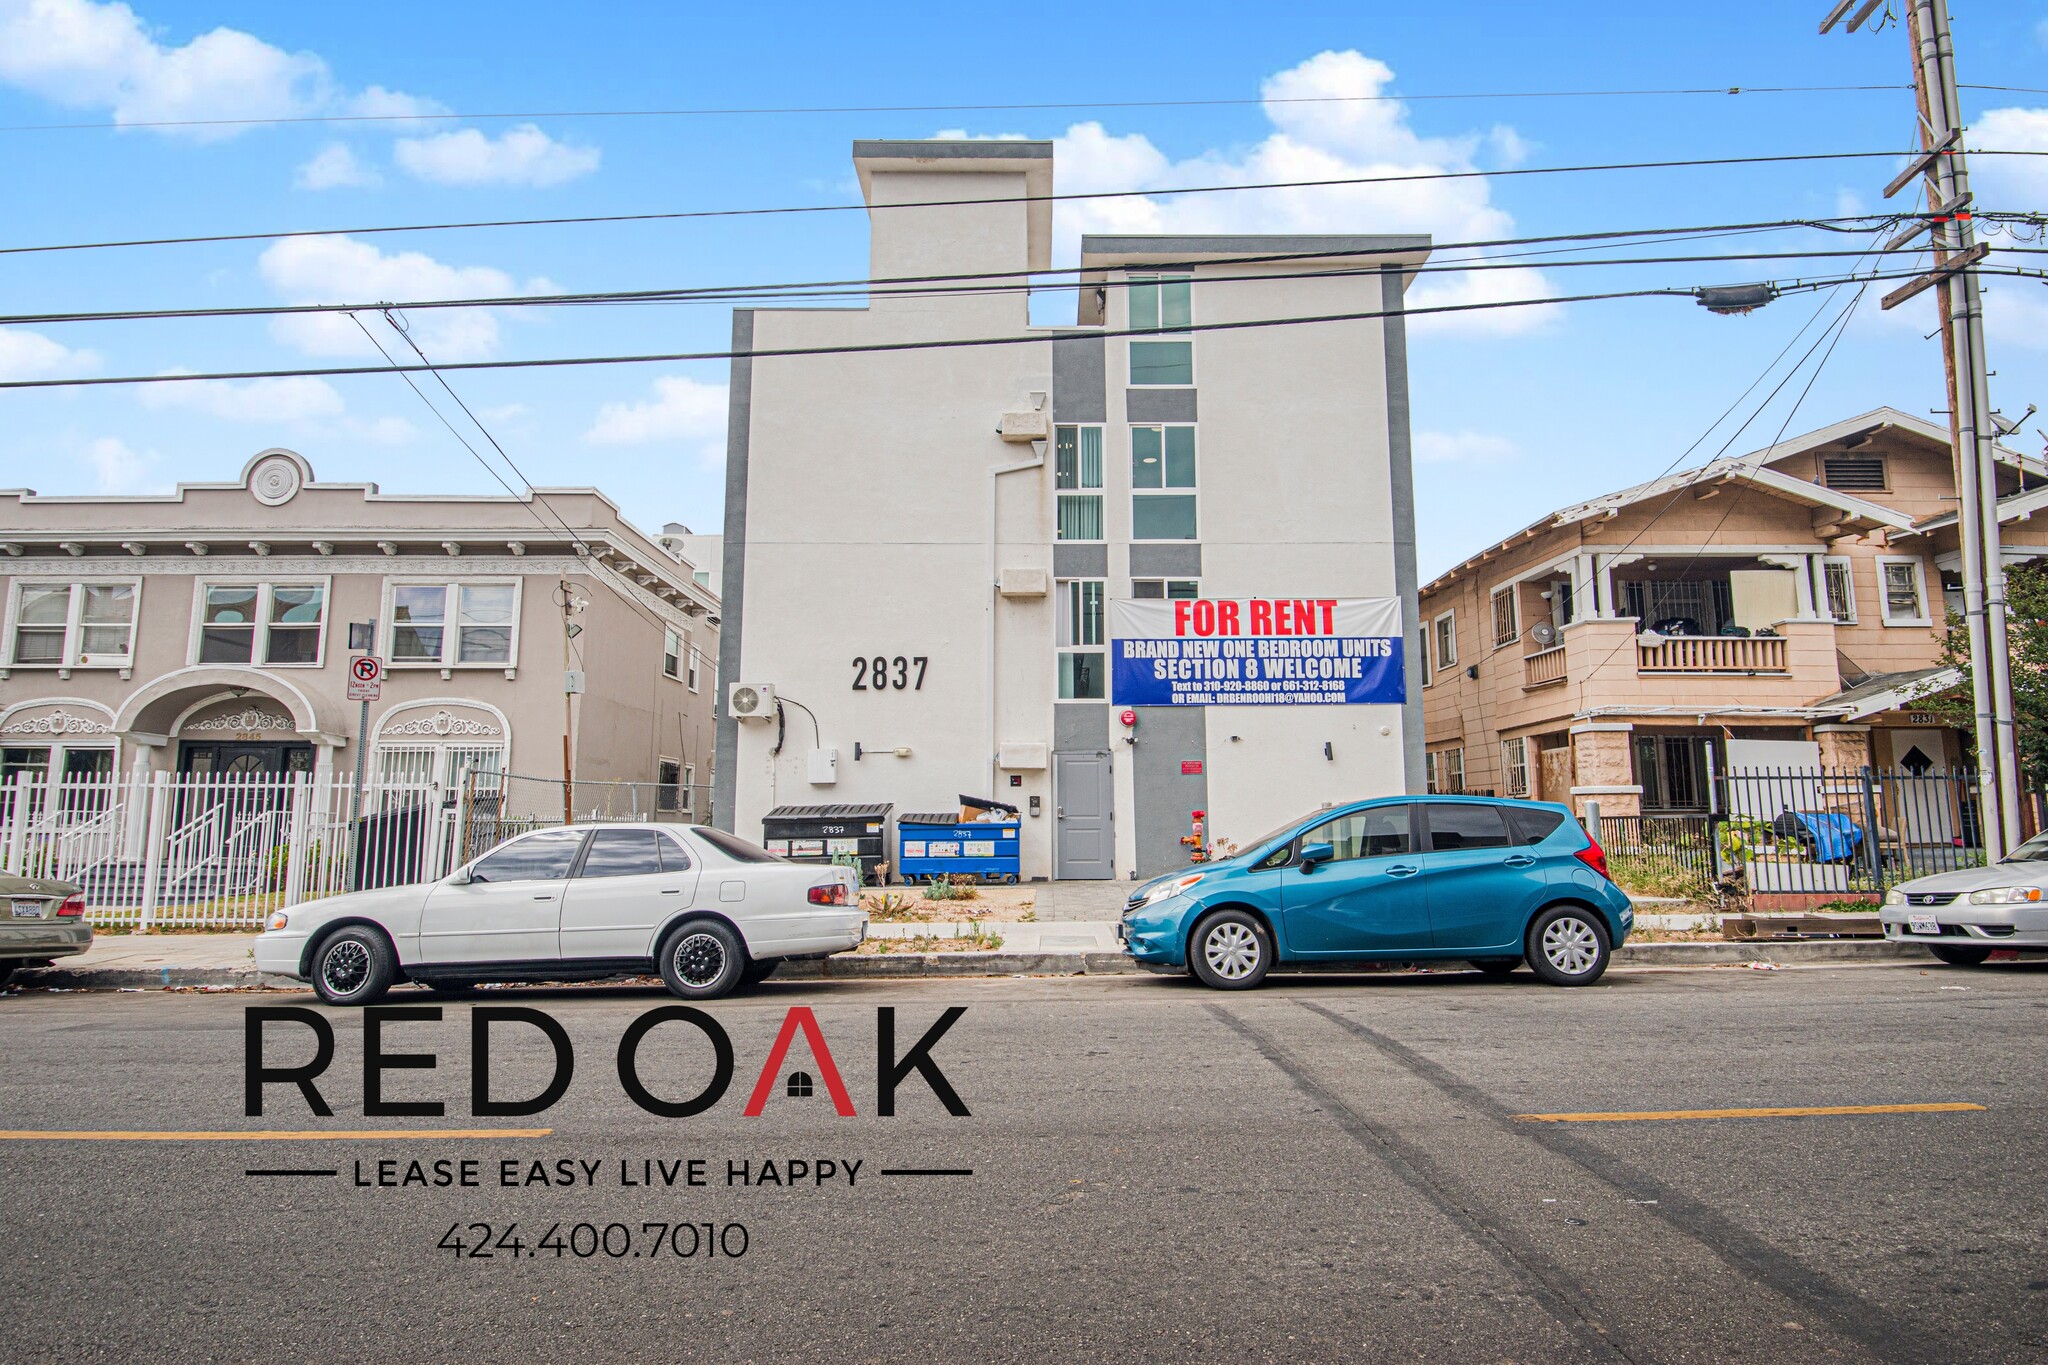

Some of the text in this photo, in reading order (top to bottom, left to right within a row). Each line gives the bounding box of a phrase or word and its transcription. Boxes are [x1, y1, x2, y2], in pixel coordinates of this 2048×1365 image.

[1174, 599, 1338, 636] FOR RENT
[1123, 639, 1392, 659] BRAND NEW ONE BEDROOM UNITS
[852, 656, 928, 690] 2837
[1153, 658, 1362, 680] SECTION 8 WELCOME
[1171, 680, 1345, 691] Text to 310-920-8860 or 661-312-8168
[1171, 693, 1185, 704] OR
[1186, 693, 1216, 704] EMAIL:
[1912, 714, 1934, 724] 2831
[236, 732, 262, 740] 2845
[822, 825, 845, 834] 2837
